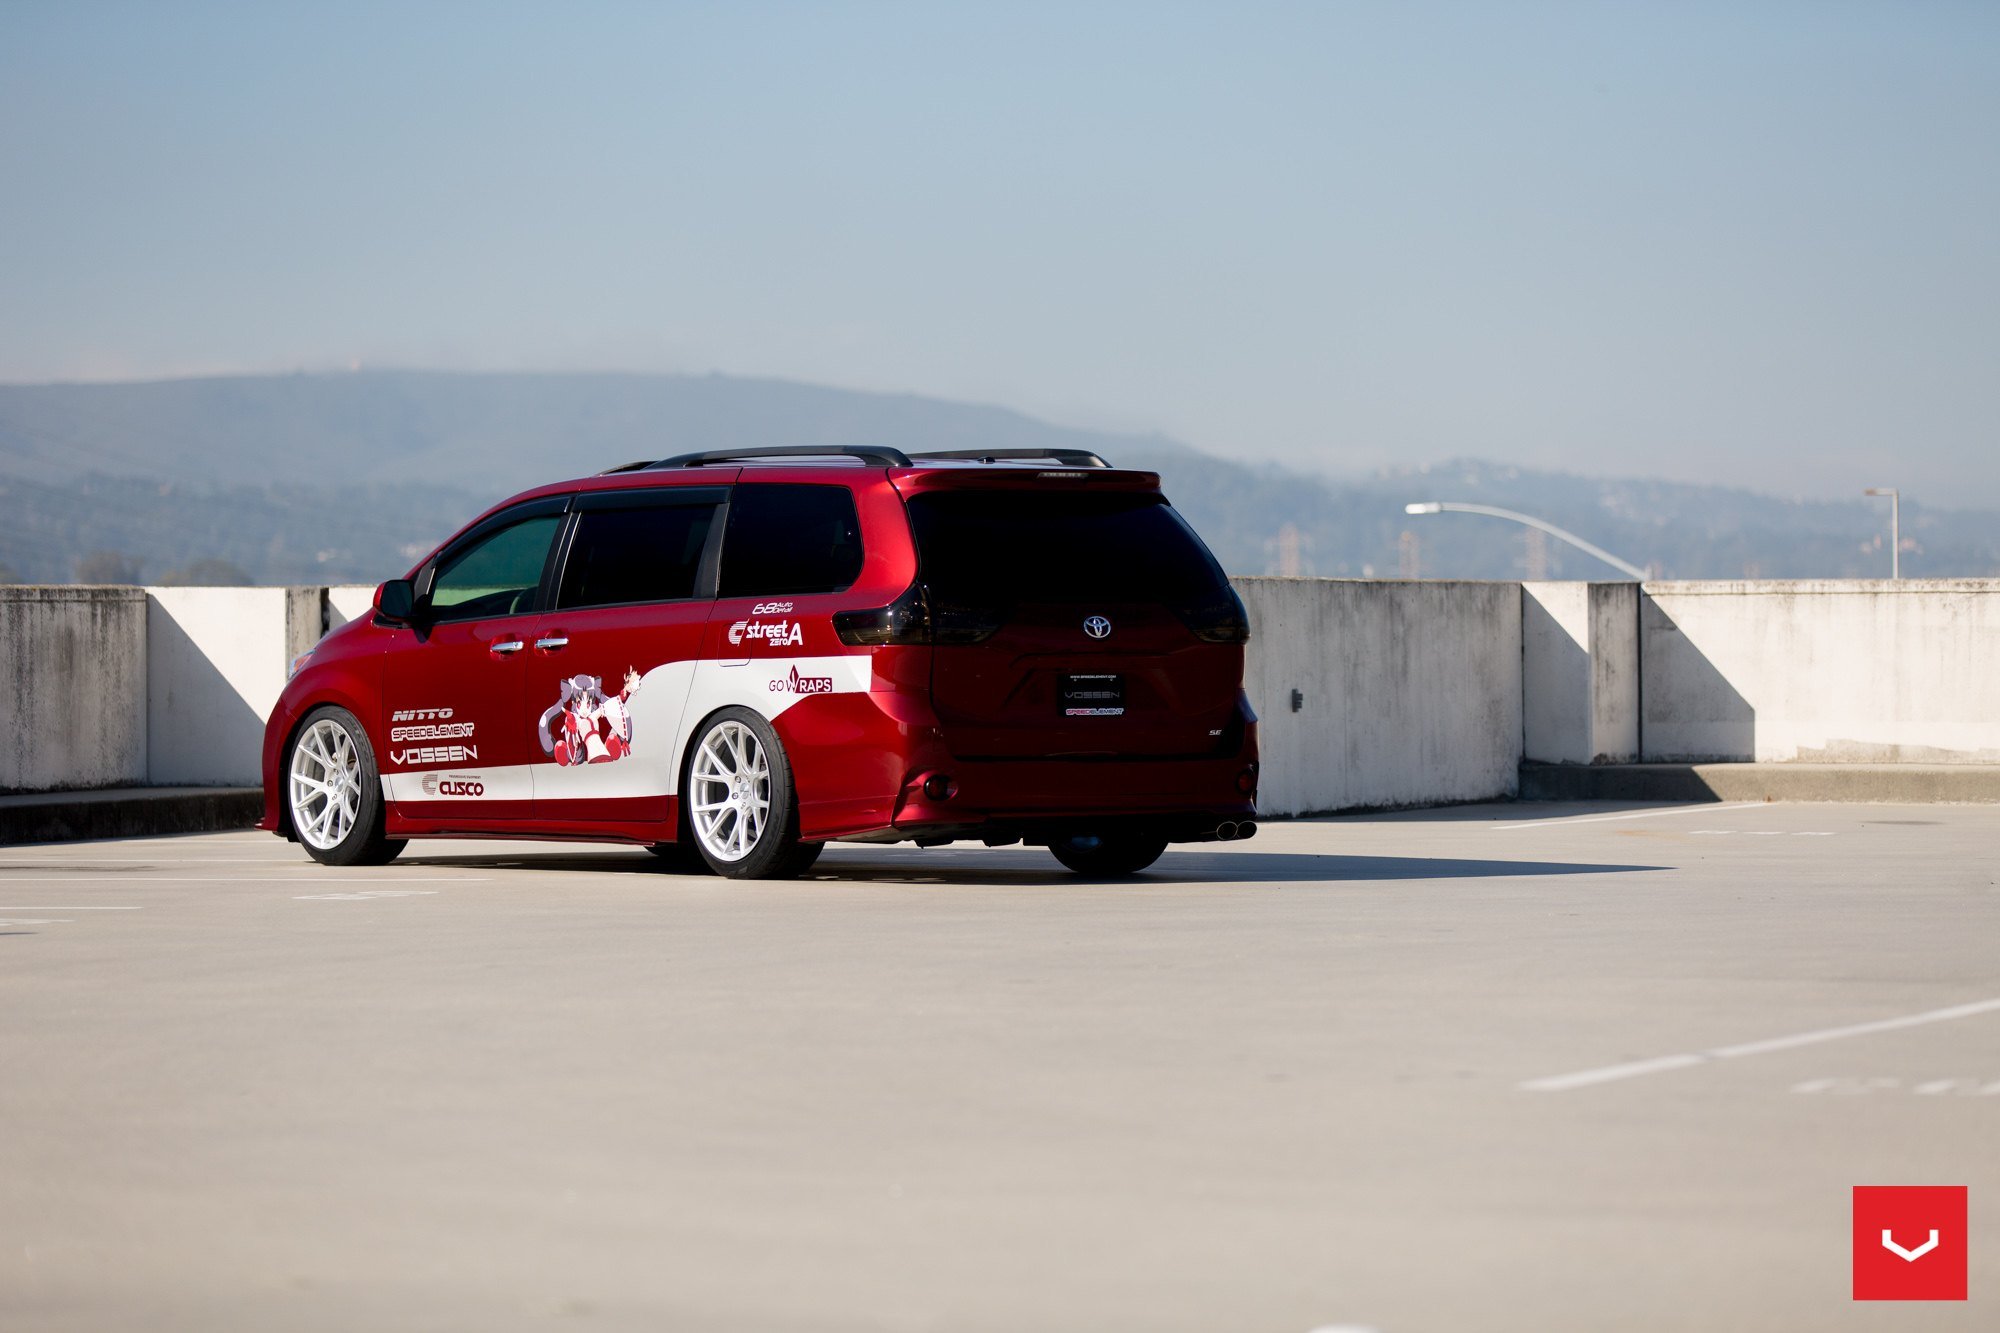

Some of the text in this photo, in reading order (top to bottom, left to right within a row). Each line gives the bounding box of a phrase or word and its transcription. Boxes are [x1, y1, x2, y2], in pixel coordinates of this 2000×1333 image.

[752, 602, 777, 615] 68
[746, 620, 789, 638] street
[768, 678, 832, 692] GO WRAPS
[1065, 691, 1120, 699] VOSSEN
[391, 708, 454, 721] NITTO
[391, 723, 474, 741] SPEEDELEMENT
[390, 744, 478, 765] VOSSEN
[440, 781, 484, 796] CUSCO
